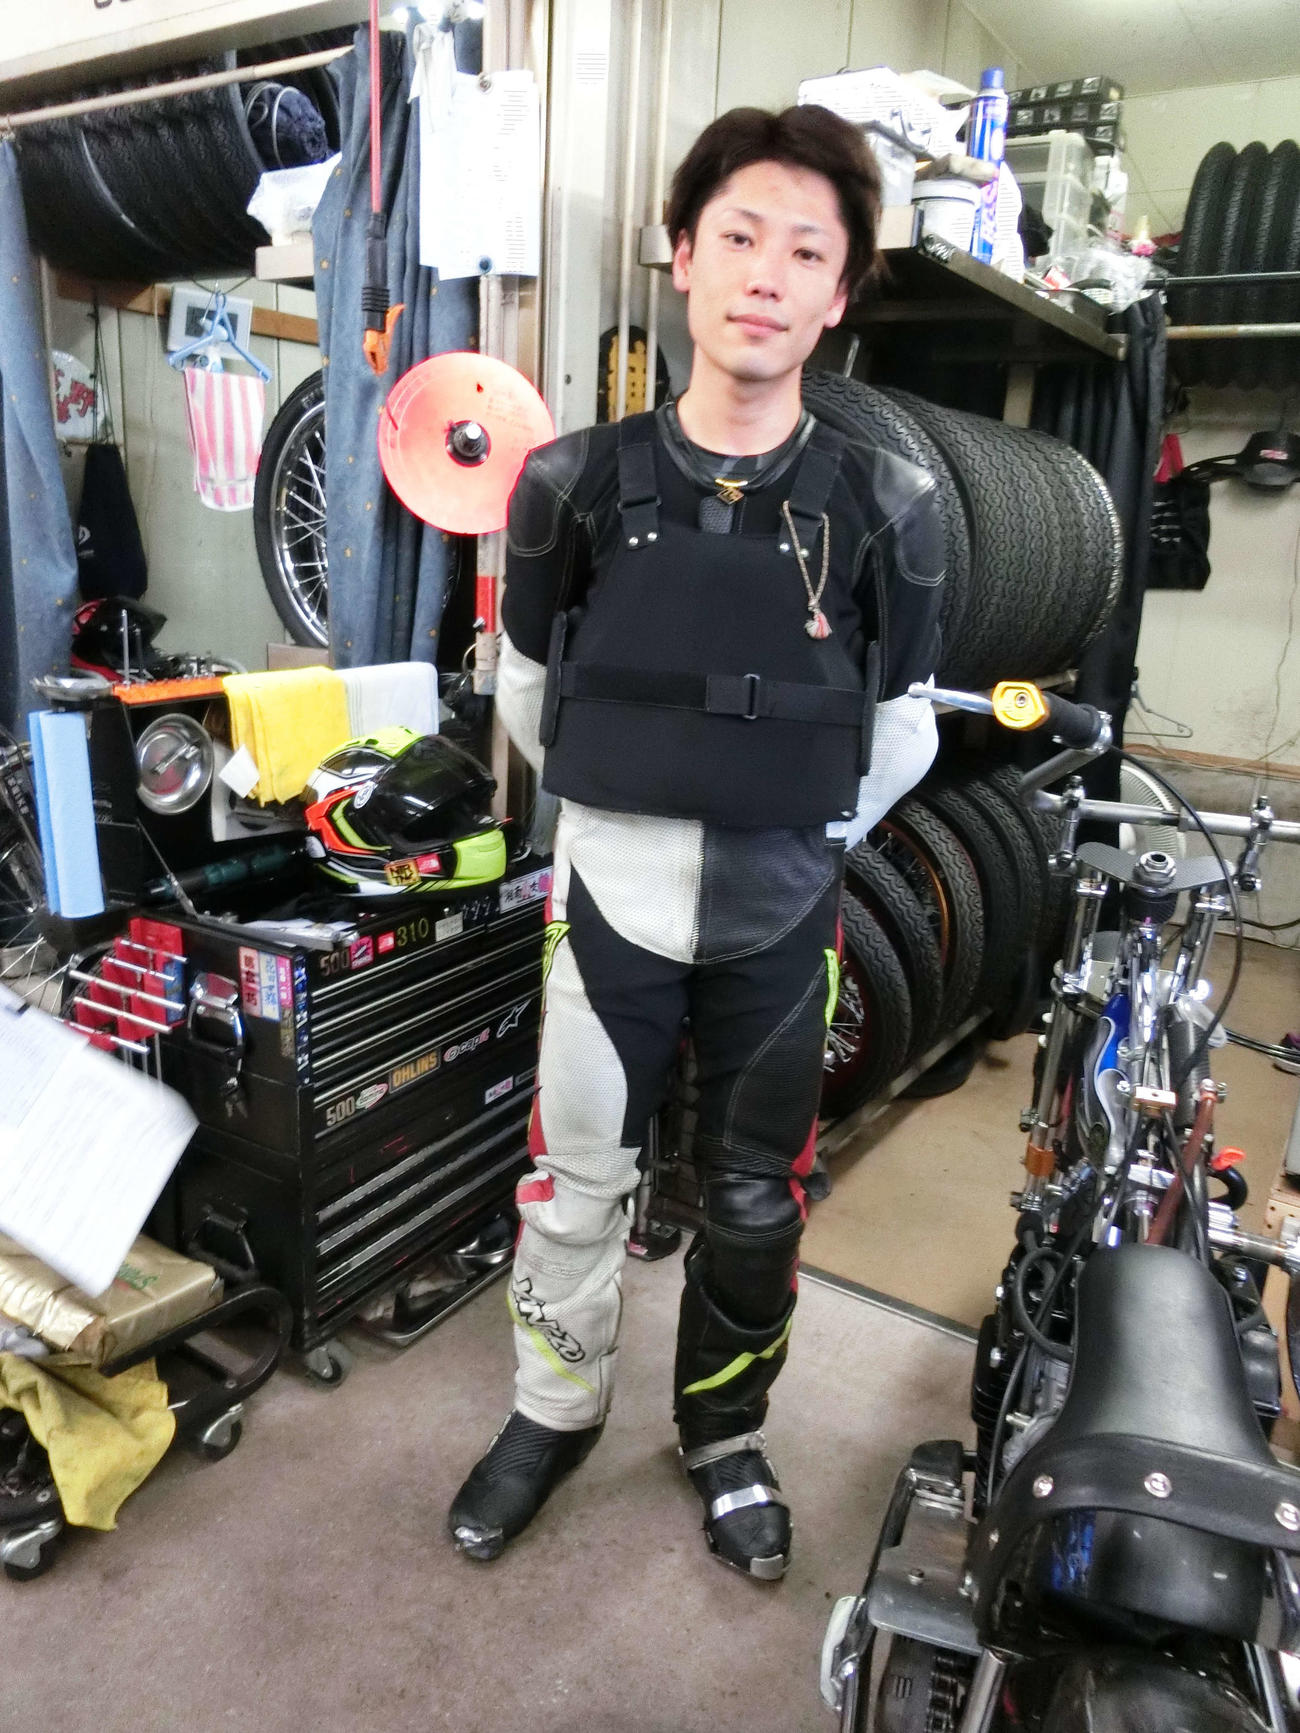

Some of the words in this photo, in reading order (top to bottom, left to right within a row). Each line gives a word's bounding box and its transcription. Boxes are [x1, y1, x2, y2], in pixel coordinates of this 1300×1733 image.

[396, 917, 429, 948] 310
[319, 947, 350, 977] 500
[326, 1095, 357, 1127] 500
